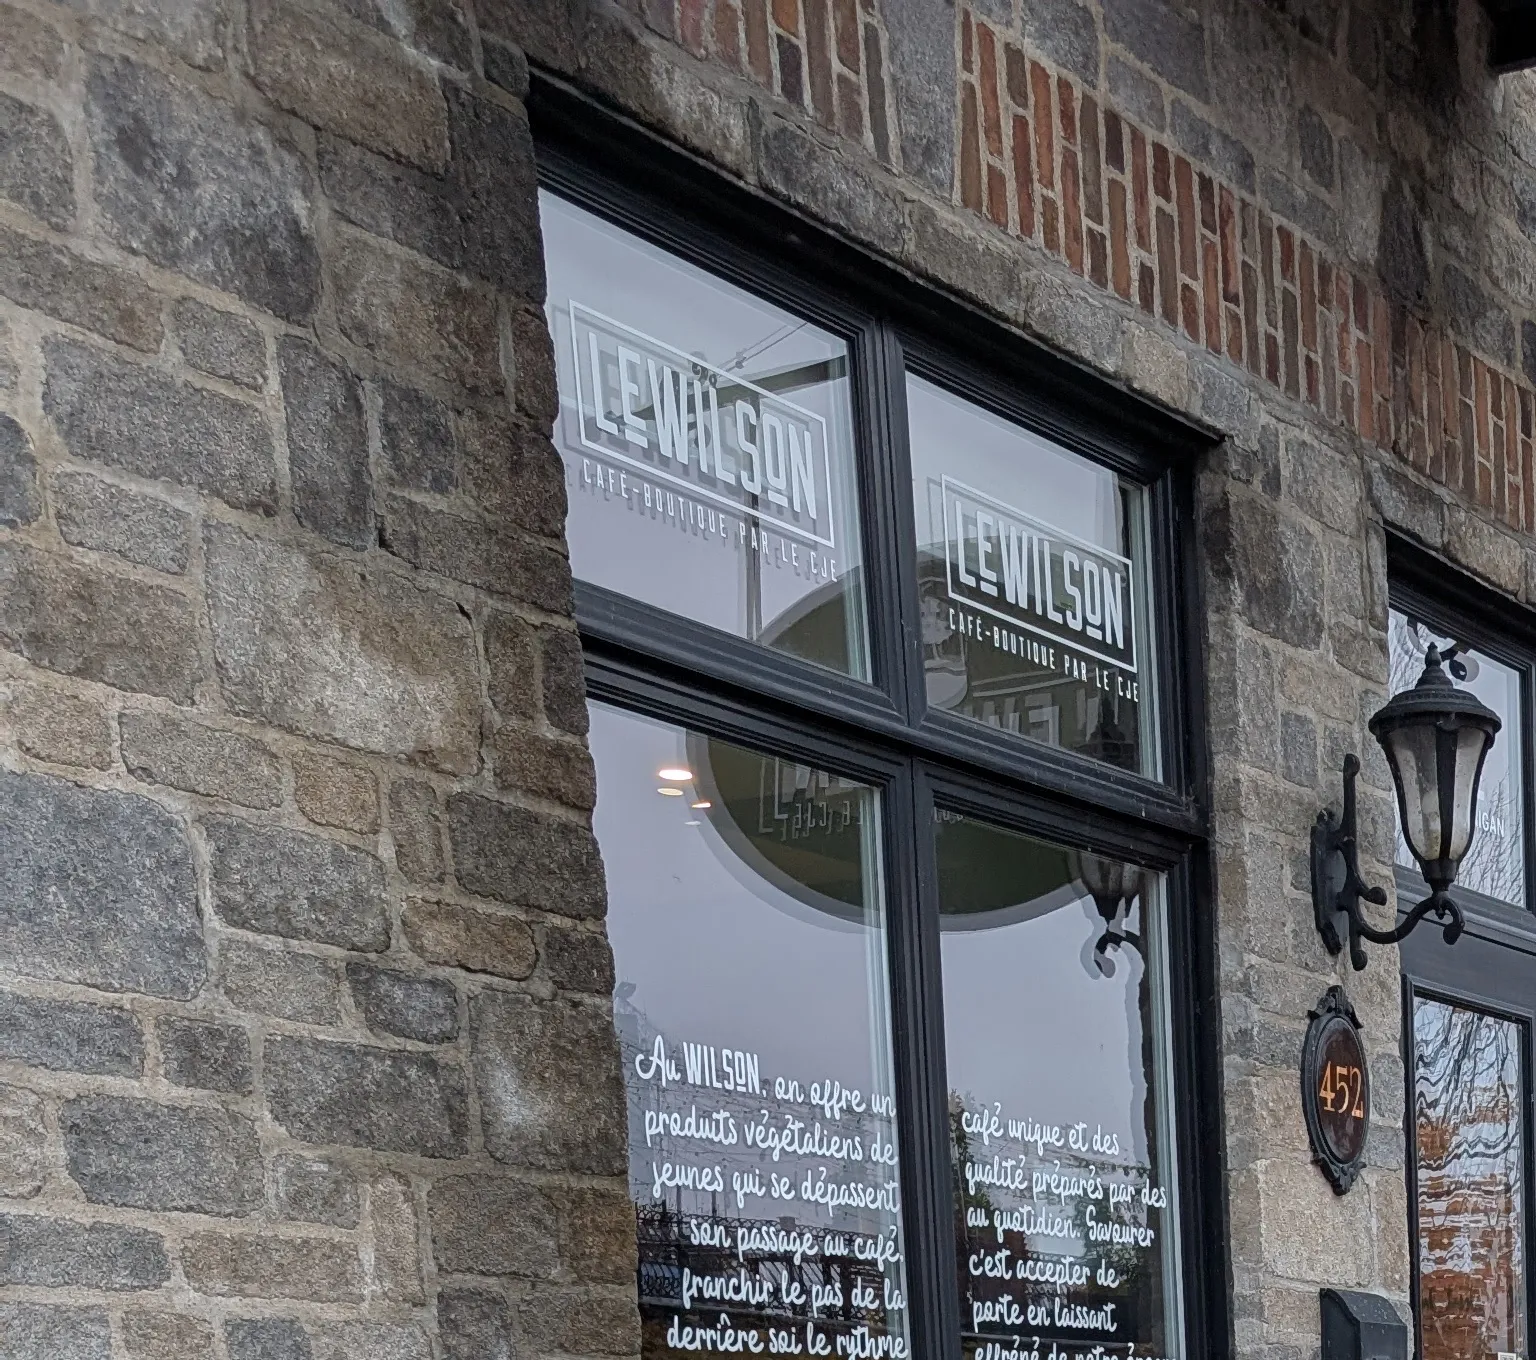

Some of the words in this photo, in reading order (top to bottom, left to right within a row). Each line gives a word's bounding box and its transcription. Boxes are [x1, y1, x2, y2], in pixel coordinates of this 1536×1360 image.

[589, 332, 817, 520] LEWILSON
[583, 459, 727, 539] CAFÉ-BOUTIQUE
[739, 522, 769, 556] PAR
[781, 539, 799, 567] LE
[811, 551, 838, 583] CJE
[955, 500, 1124, 650] LEWILSON
[949, 608, 1056, 670] CAFÉ-BOUTIQUE
[1064, 655, 1087, 683] PAR
[1096, 667, 1110, 691] LE
[1118, 677, 1139, 703] CJE
[635, 1035, 681, 1088] Au
[775, 1077, 804, 1105] on
[810, 1079, 866, 1120] offre
[872, 1092, 896, 1118] un
[962, 1102, 1004, 1146] café
[1008, 1117, 1065, 1157] unique
[1069, 1121, 1089, 1152] et
[1092, 1124, 1120, 1156] des
[1319, 1061, 1364, 1119] 452
[645, 1105, 738, 1148] produits
[744, 1109, 863, 1162] végétaliens
[871, 1131, 899, 1166] de
[965, 1154, 1028, 1196] qualité
[1032, 1160, 1104, 1206] préparés
[1109, 1180, 1136, 1212] par
[1141, 1178, 1168, 1209] des
[653, 1161, 724, 1199] jeunes
[733, 1169, 766, 1209] qui
[771, 1172, 796, 1200] se
[801, 1166, 901, 1217] dépassent
[967, 1206, 990, 1228] au
[994, 1204, 1081, 1244] quotidien.
[1086, 1205, 1155, 1248] Savourer
[682, 1267, 774, 1310] franchir
[781, 1269, 807, 1302] le
[811, 1280, 843, 1317] pas
[851, 1275, 880, 1311] de
[884, 1278, 907, 1311] la
[972, 1293, 1025, 1334] porte
[1027, 1304, 1051, 1327] en
[1054, 1296, 1118, 1333] laissant
[690, 1218, 732, 1248] son
[737, 1225, 818, 1266] passage
[824, 1235, 849, 1257] au
[969, 1248, 1013, 1281] c'est
[1016, 1255, 1091, 1294] accepter
[1096, 1258, 1120, 1289] de
[769, 1326, 803, 1355] soi
[806, 1321, 832, 1356] le
